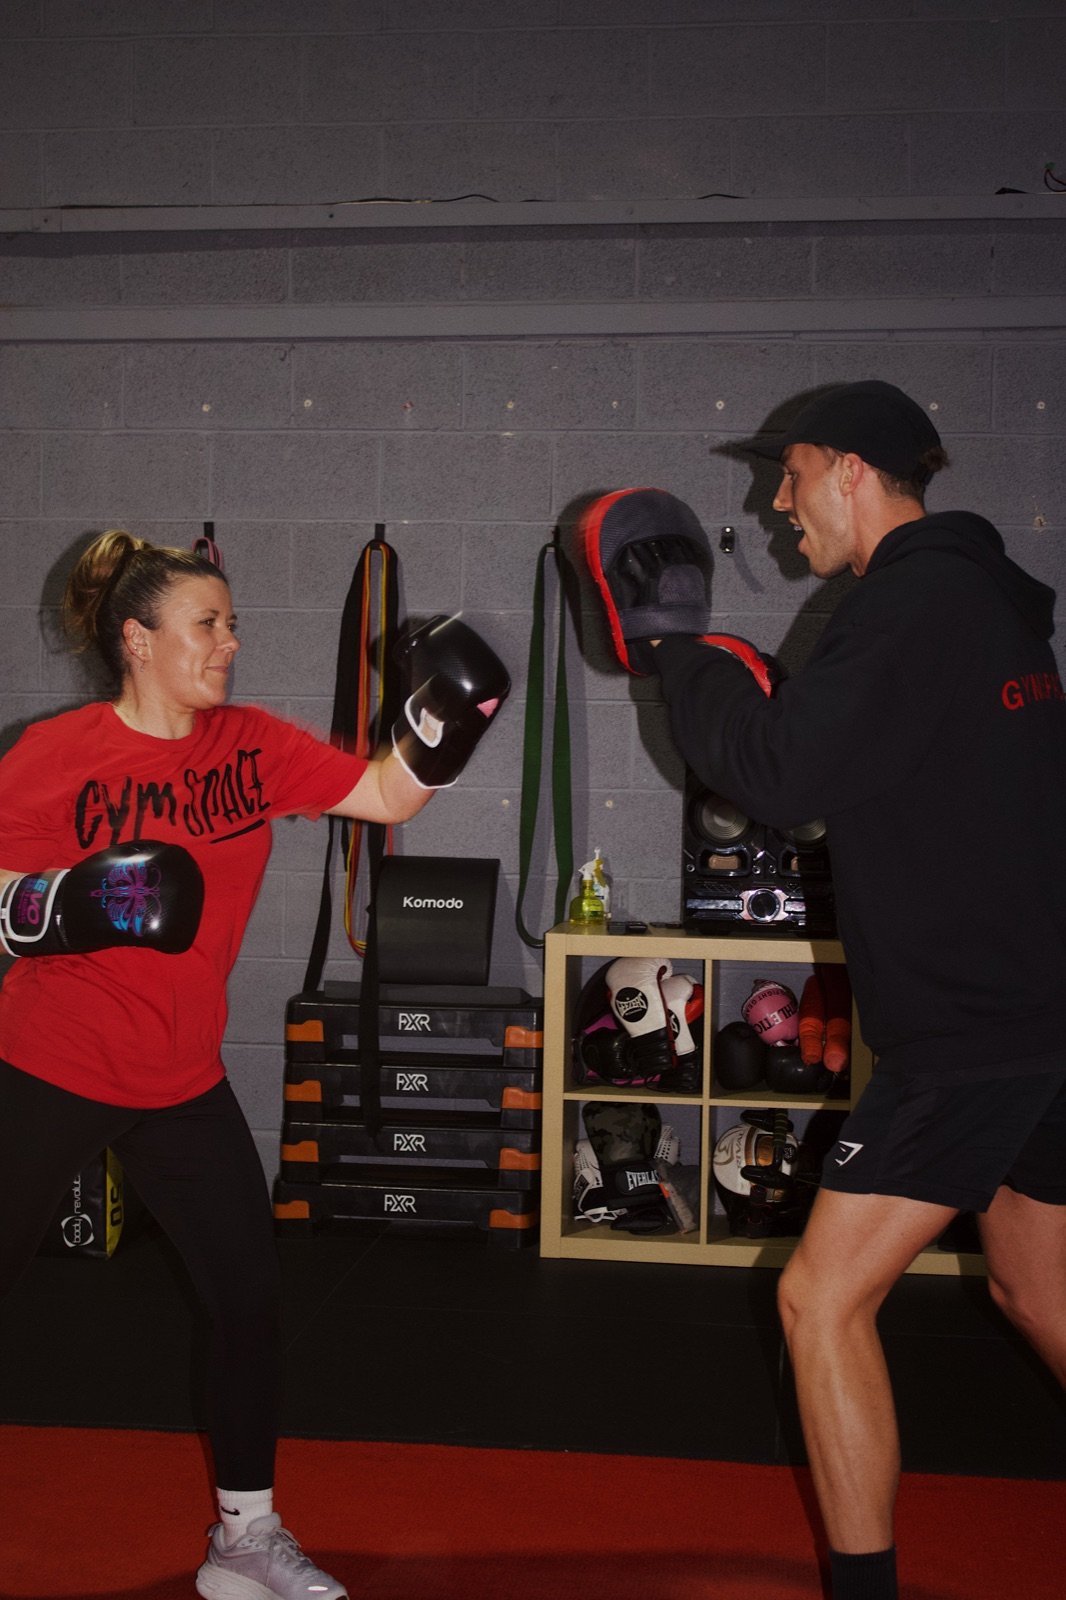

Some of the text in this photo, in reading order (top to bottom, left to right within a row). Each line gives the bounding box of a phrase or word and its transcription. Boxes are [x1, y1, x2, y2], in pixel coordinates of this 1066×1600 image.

[183, 748, 271, 836] SPACE
[402, 896, 464, 909] Komodo
[72, 1173, 83, 1244] body revolut
